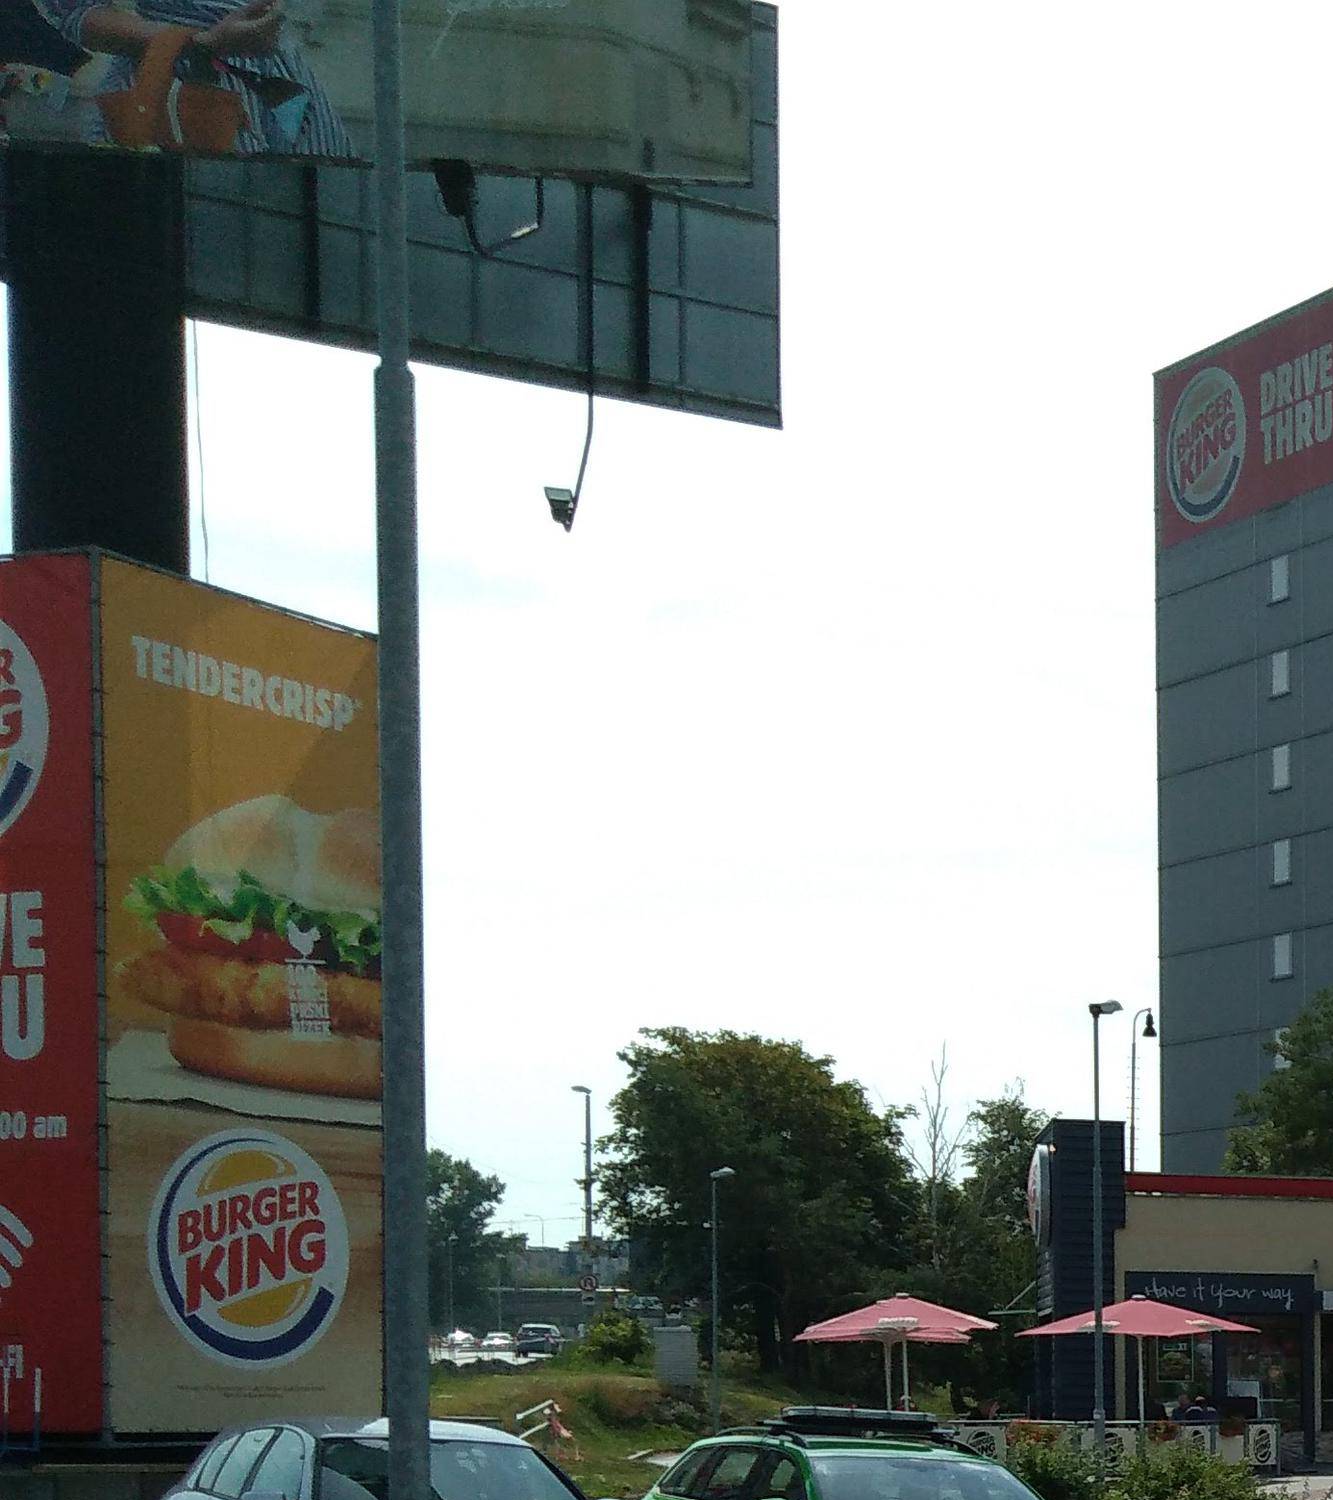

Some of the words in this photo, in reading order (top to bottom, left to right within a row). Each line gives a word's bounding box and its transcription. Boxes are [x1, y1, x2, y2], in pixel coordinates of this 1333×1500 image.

[1175, 388, 1234, 459] BURGER
[1179, 418, 1238, 488] KING
[1262, 392, 1333, 465] THRU
[131, 635, 356, 731] TENDERCRISP
[177, 1181, 321, 1255] BURGER
[184, 1219, 327, 1316] KING
[1145, 1277, 1186, 1299] Have
[1194, 1277, 1205, 1301] it
[1261, 1287, 1295, 1311] way
